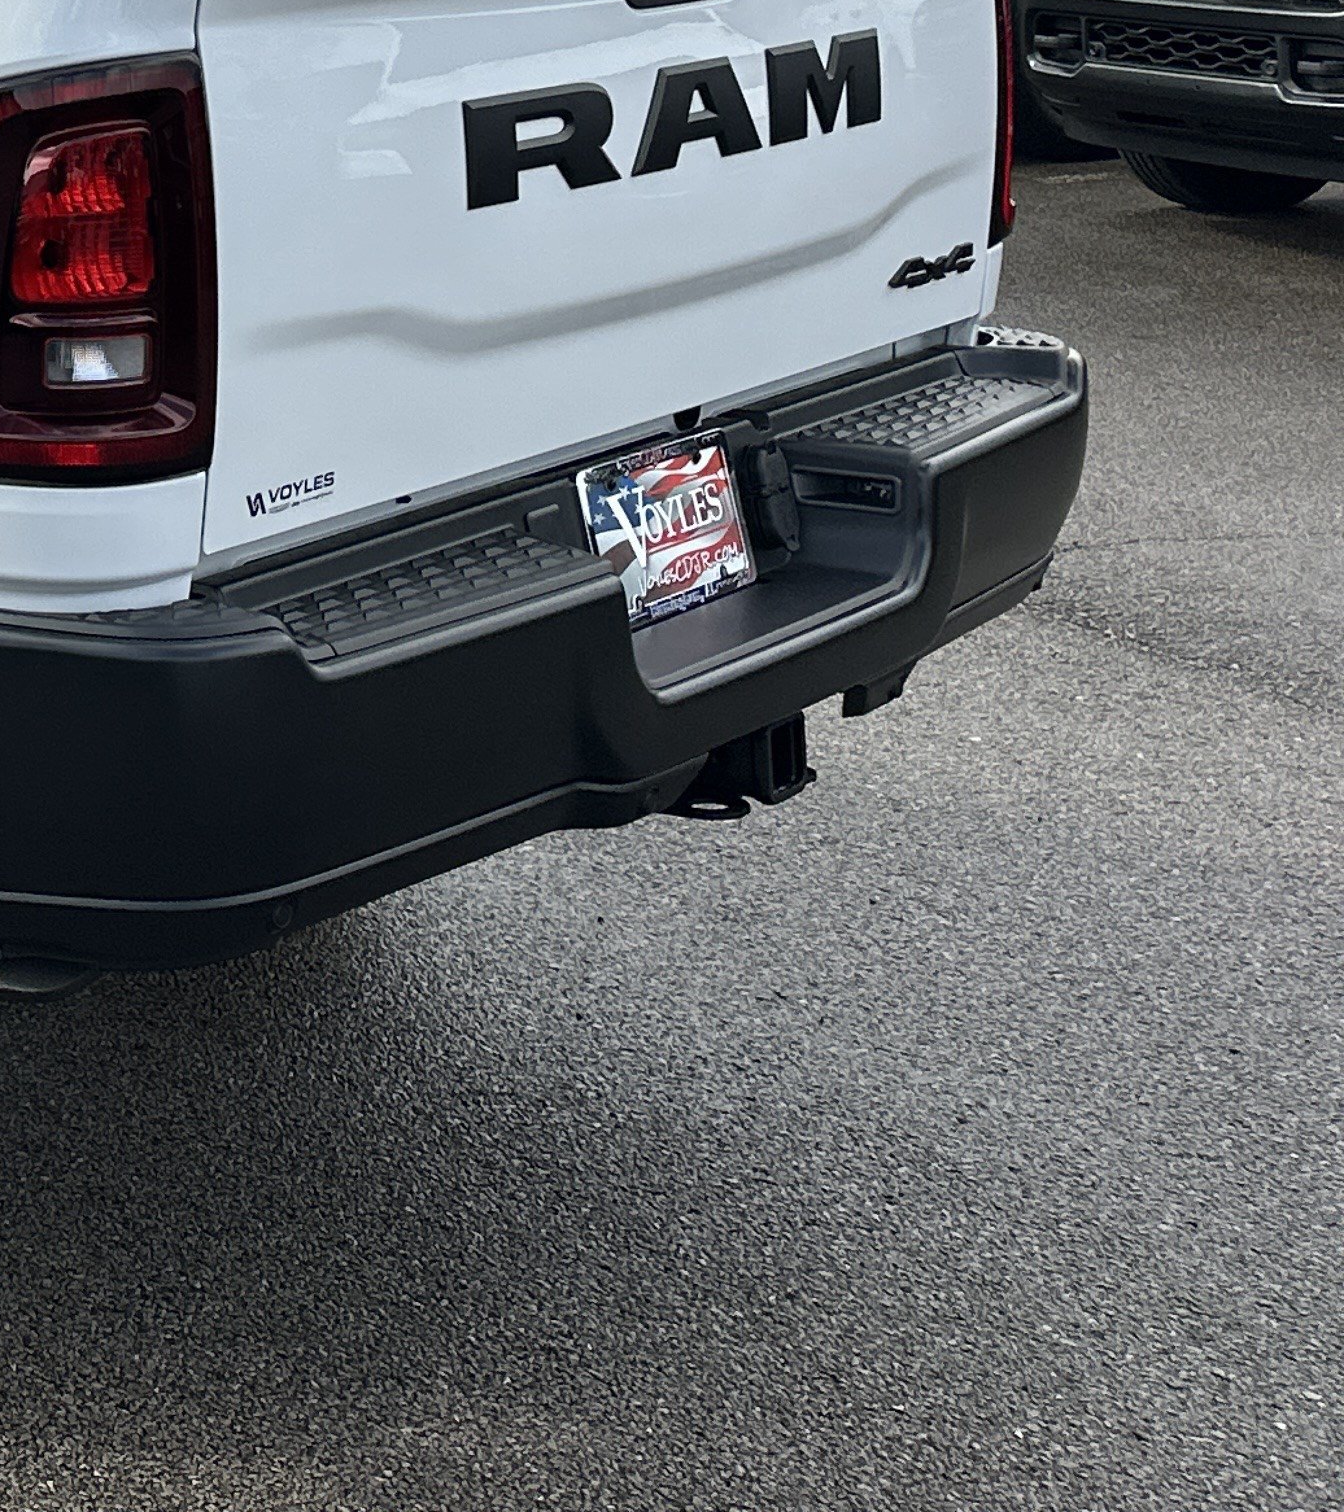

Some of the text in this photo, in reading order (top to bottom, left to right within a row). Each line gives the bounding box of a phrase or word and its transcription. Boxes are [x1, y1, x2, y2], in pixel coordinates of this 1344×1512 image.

[462, 28, 882, 210] RAM
[268, 471, 335, 503] VOYLES
[606, 483, 724, 569] VOYLES
